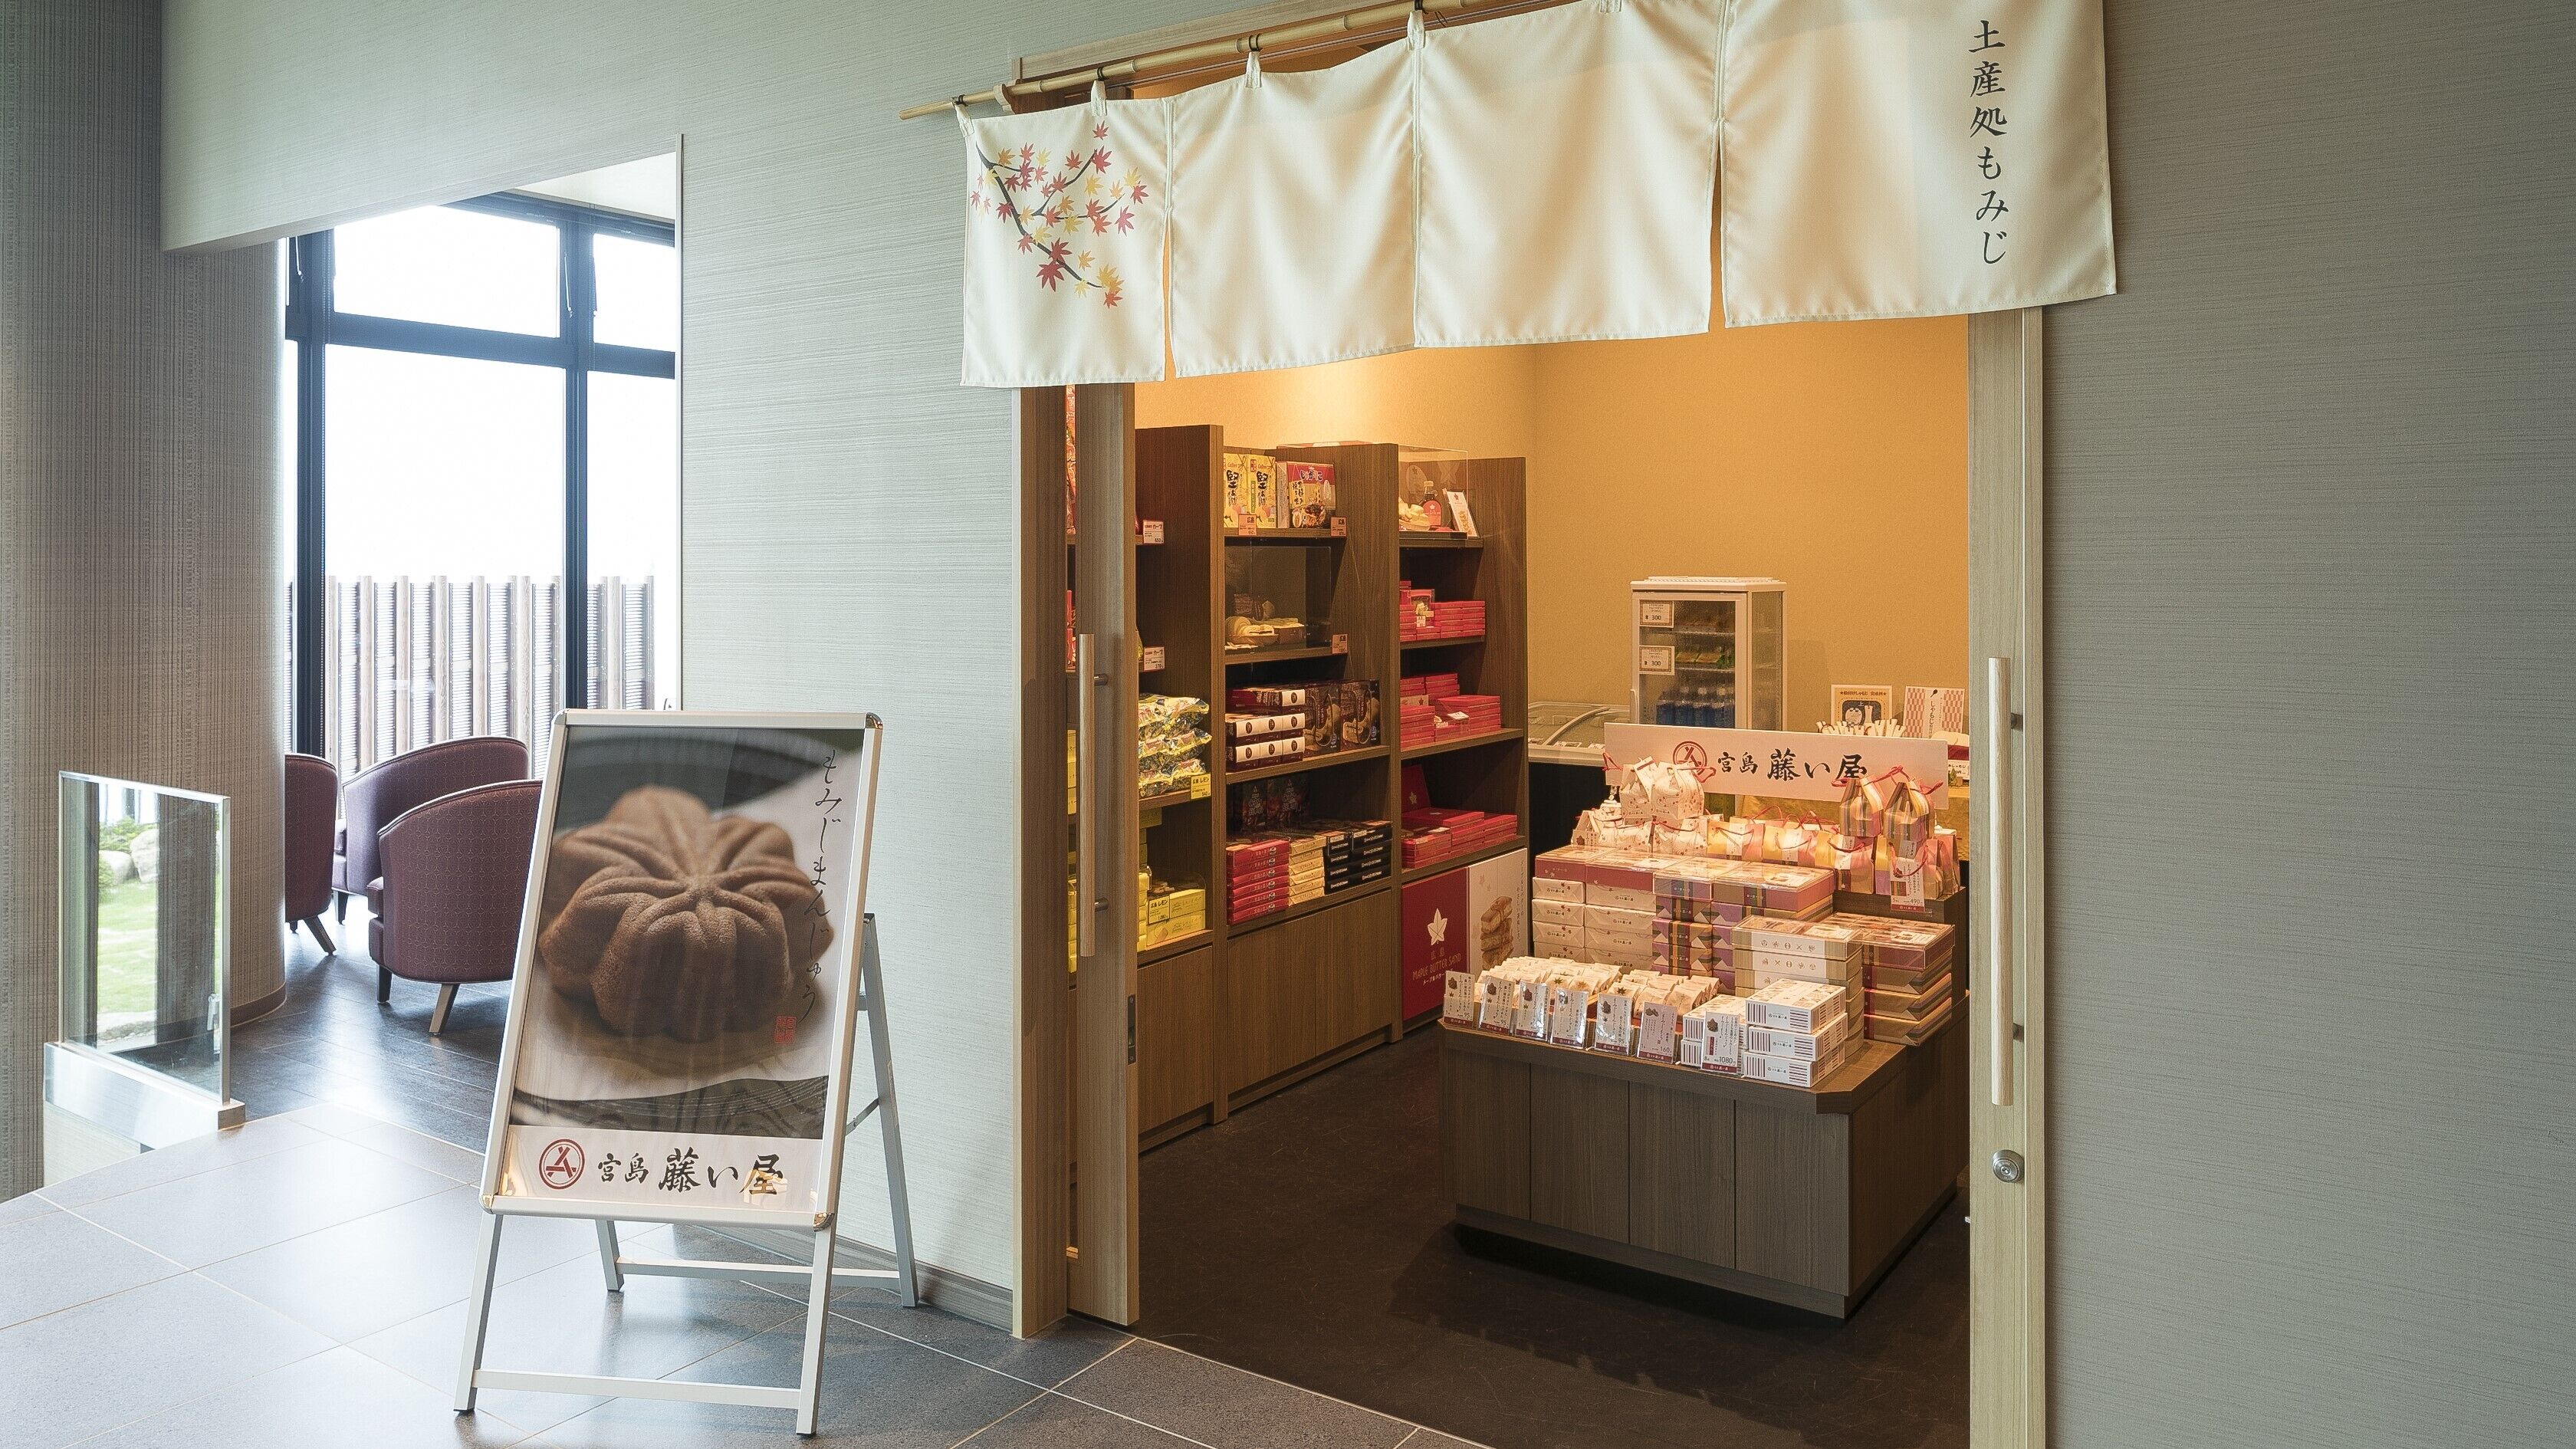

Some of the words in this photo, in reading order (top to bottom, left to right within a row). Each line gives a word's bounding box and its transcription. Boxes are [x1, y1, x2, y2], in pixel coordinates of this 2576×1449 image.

[1968, 19, 2009, 265] 土産処もみじ
[797, 748, 843, 1024] もみじまんじゅう
